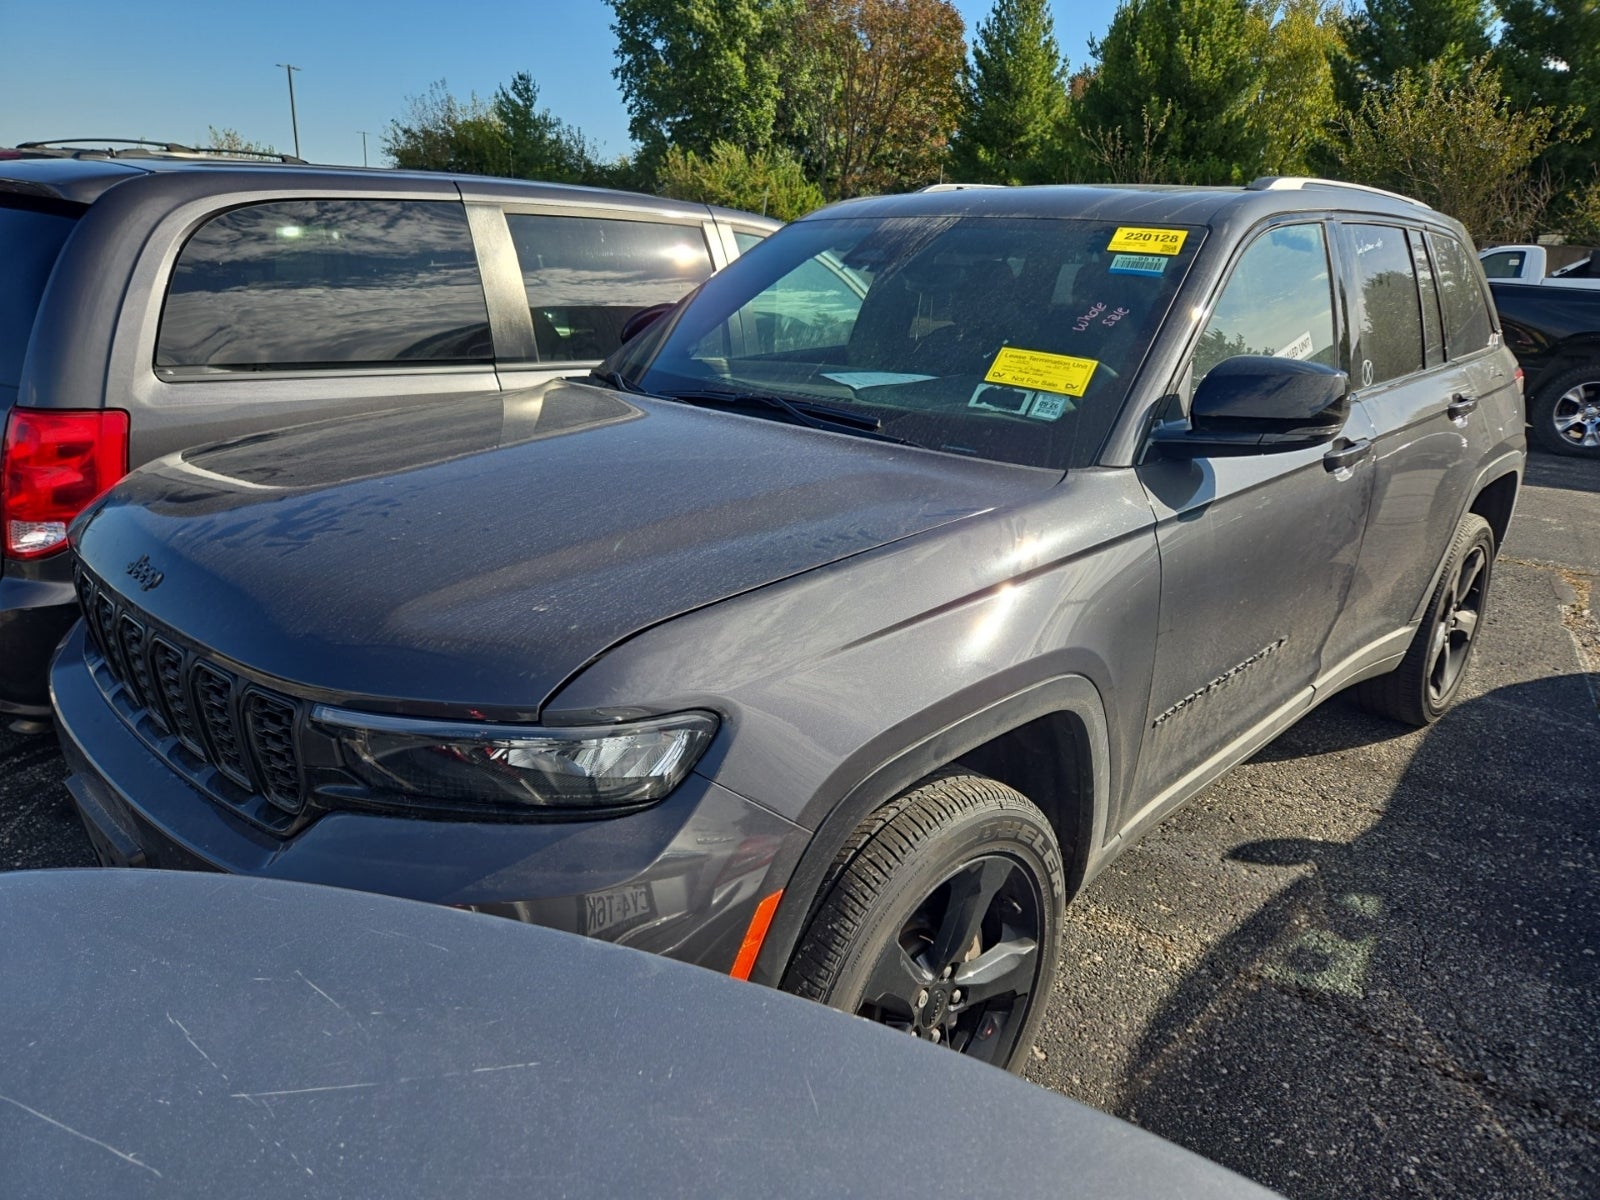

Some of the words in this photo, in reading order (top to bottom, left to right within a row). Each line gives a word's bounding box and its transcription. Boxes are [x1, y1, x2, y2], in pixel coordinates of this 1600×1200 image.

[1124, 232, 1179, 243] 220128
[1004, 352, 1027, 361] Lease
[1029, 356, 1071, 367] Termination
[1072, 362, 1089, 370] Unit
[1042, 379, 1058, 387] Sale
[126, 553, 165, 592] Jeep
[975, 820, 1063, 898] DUELER
